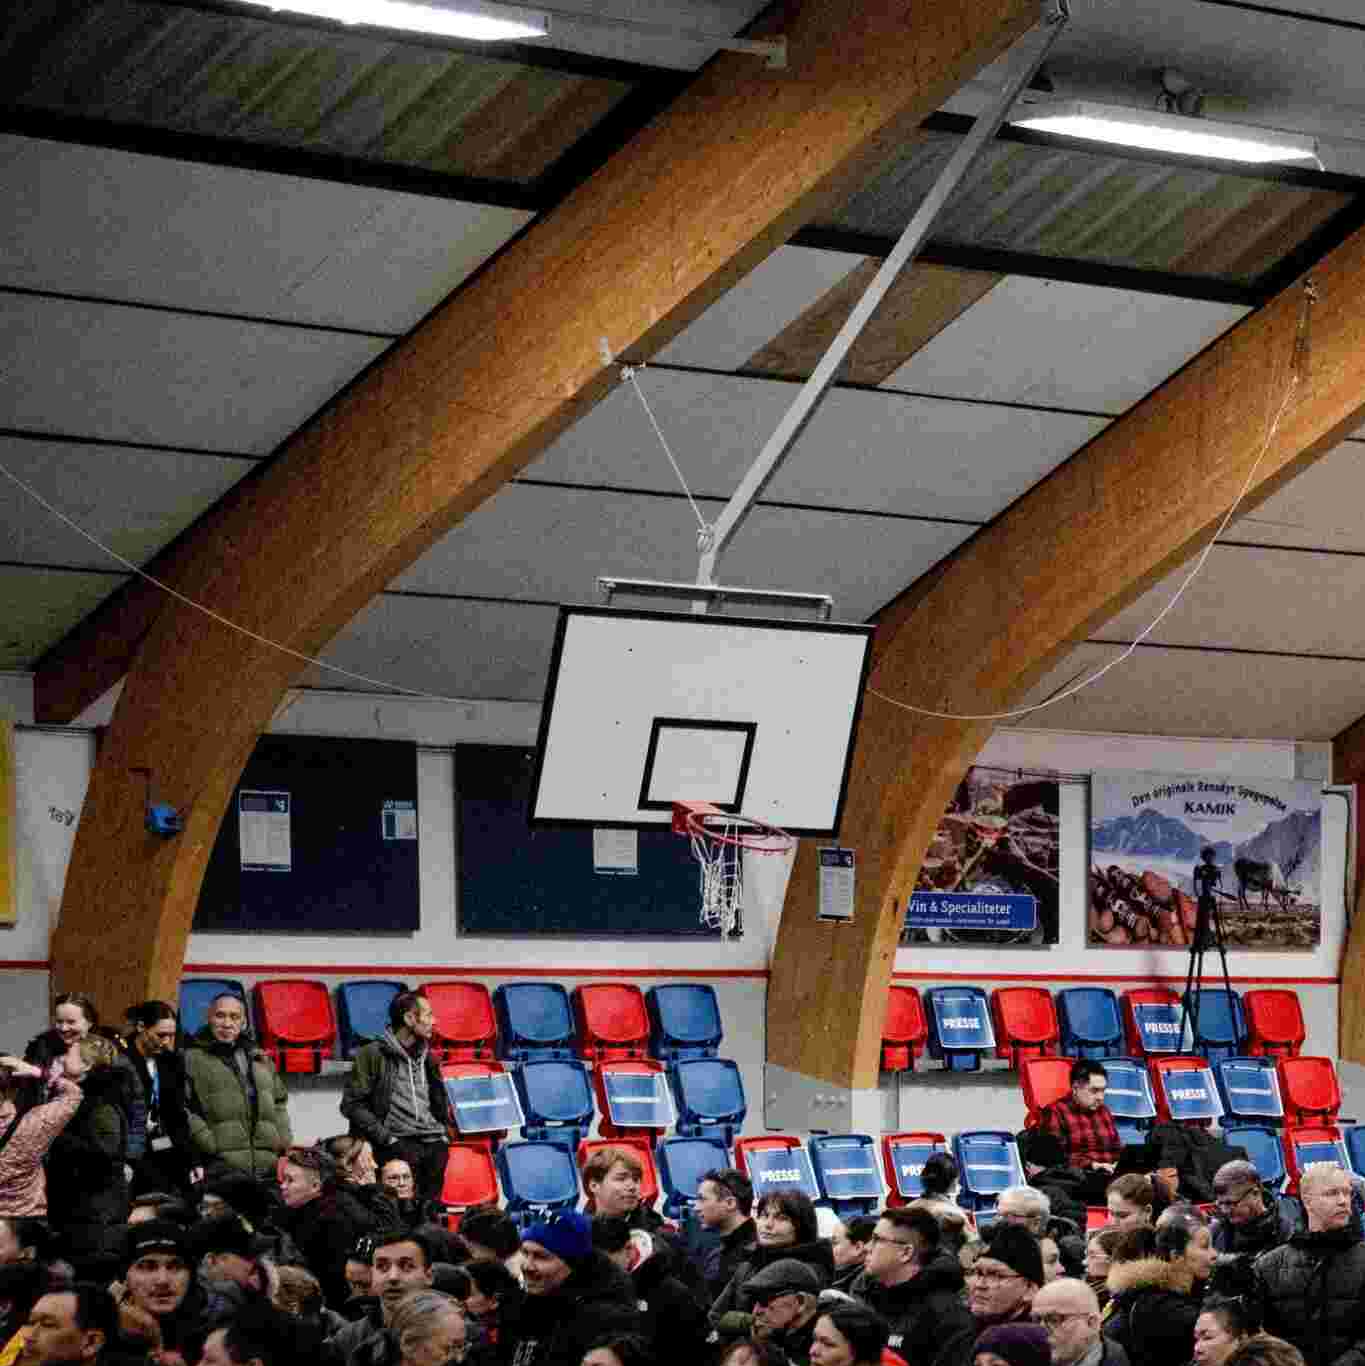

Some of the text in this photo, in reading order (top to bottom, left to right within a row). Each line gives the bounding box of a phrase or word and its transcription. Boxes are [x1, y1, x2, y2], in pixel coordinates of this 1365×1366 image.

[1184, 801, 1236, 816] KAMIK
[941, 900, 1011, 916] Specialiteter
[942, 1017, 981, 1030] PRESSE
[1144, 1022, 1182, 1034] PRESSE
[759, 1169, 801, 1183] PRESSE
